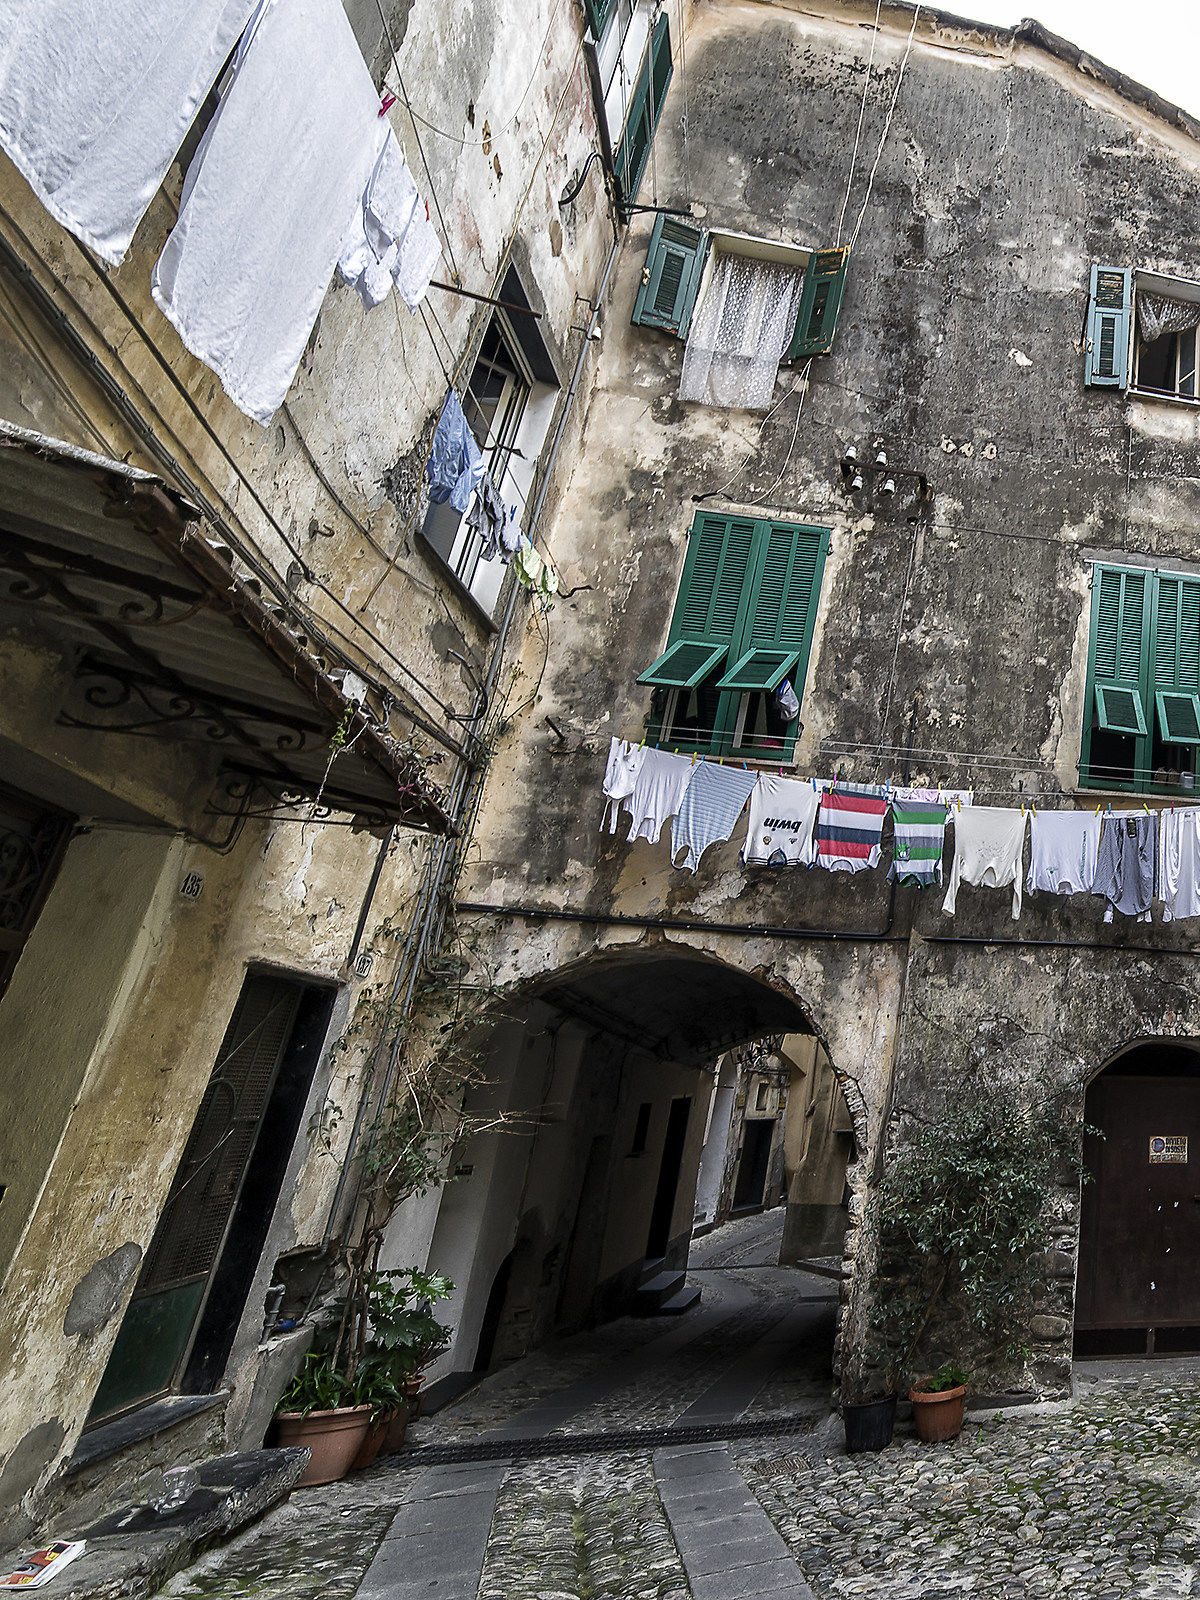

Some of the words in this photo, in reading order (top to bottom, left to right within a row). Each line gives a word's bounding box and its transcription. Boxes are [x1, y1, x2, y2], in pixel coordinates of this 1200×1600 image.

[763, 817, 803, 834] bwin
[180, 872, 203, 897] 135
[356, 956, 371, 975] 137
